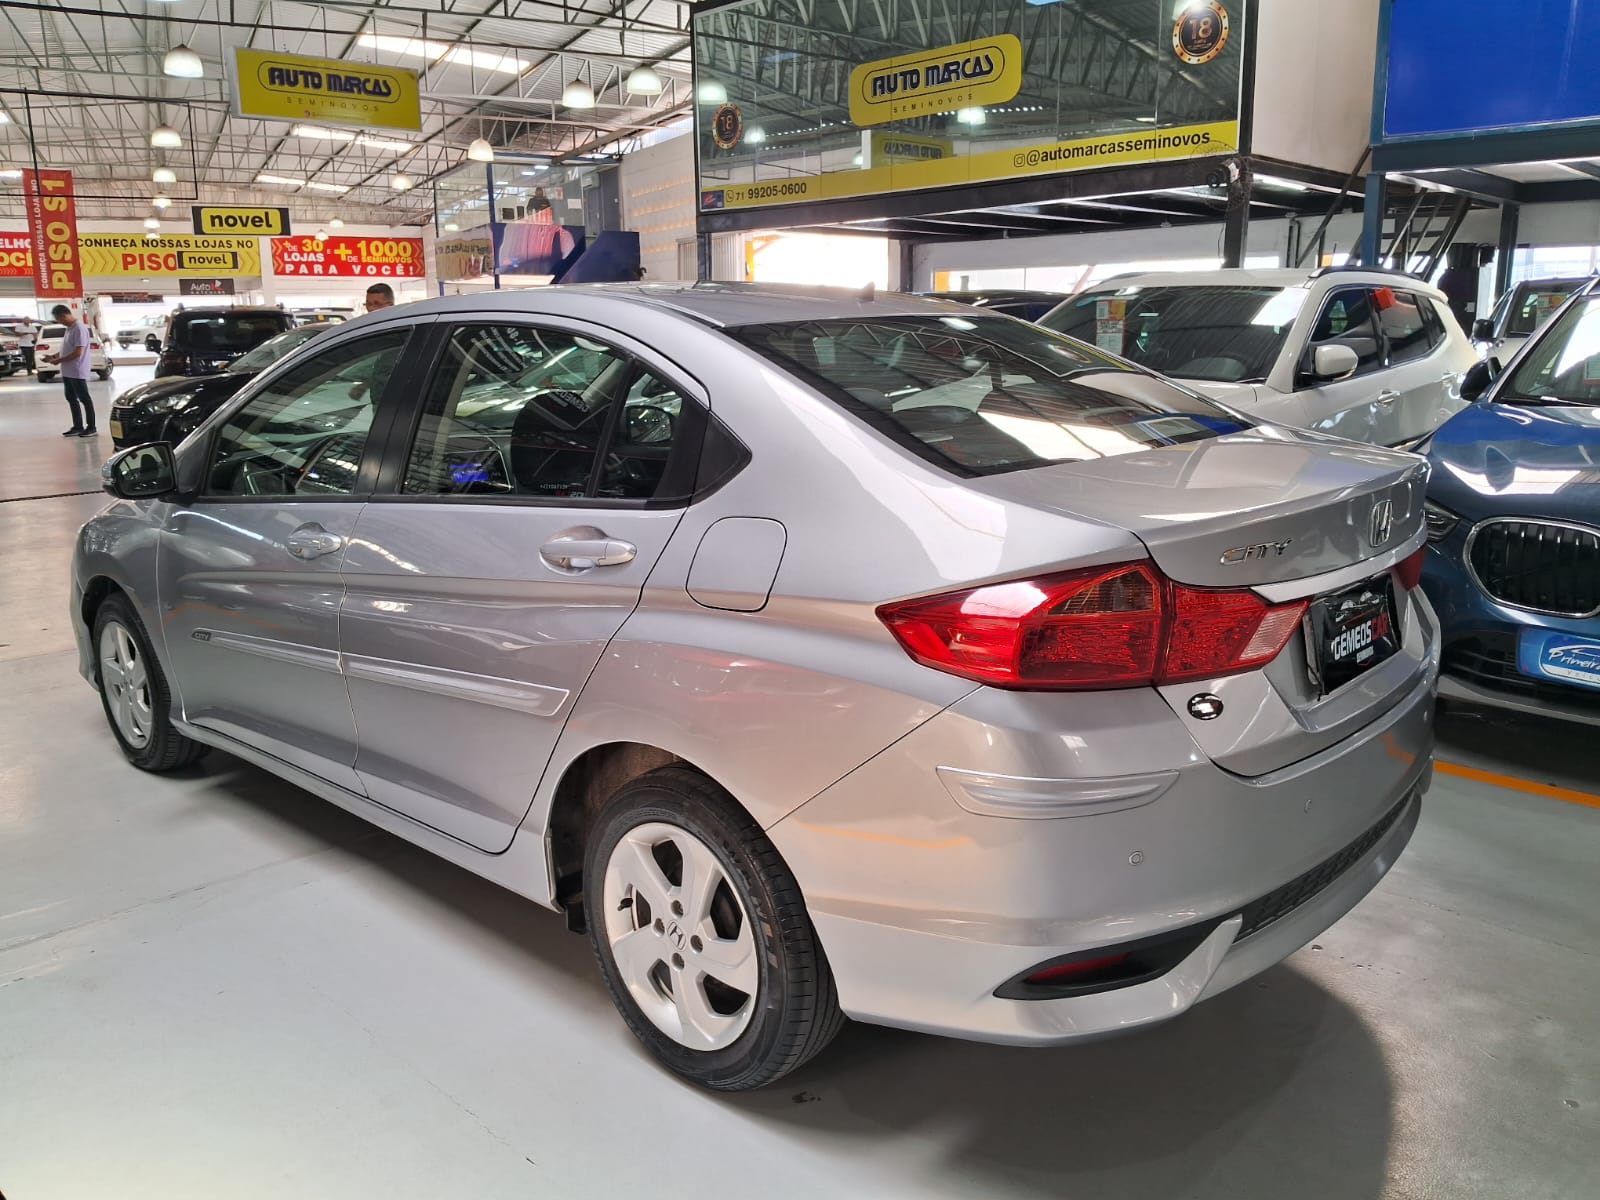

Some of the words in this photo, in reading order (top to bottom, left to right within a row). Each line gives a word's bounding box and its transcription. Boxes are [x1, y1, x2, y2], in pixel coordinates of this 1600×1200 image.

[1189, 17, 1212, 40] 18
[268, 67, 323, 90] AUTO
[326, 73, 392, 98] MARCAS
[871, 69, 921, 98] AUTO
[924, 54, 995, 89] MARCAS
[286, 96, 380, 113] SEMINOVOS
[893, 92, 973, 114] SEMINOVOS
[1026, 131, 1211, 167] @automarcasseminovos
[41, 179, 69, 212] S1
[736, 192, 745, 201] 71
[748, 183, 808, 199] 99205-0600
[209, 211, 273, 228] novel
[141, 238, 191, 249] NOSSAS
[194, 239, 233, 249] LOJAS
[237, 240, 254, 249] NO
[302, 239, 324, 252] 30
[357, 240, 413, 257] 1000
[46, 221, 76, 290] PISO
[188, 253, 229, 265] novel
[284, 252, 325, 262] LOJAS
[285, 263, 339, 274] PARA
[352, 264, 414, 275] VOCÊ!
[1219, 537, 1293, 566] CITY
